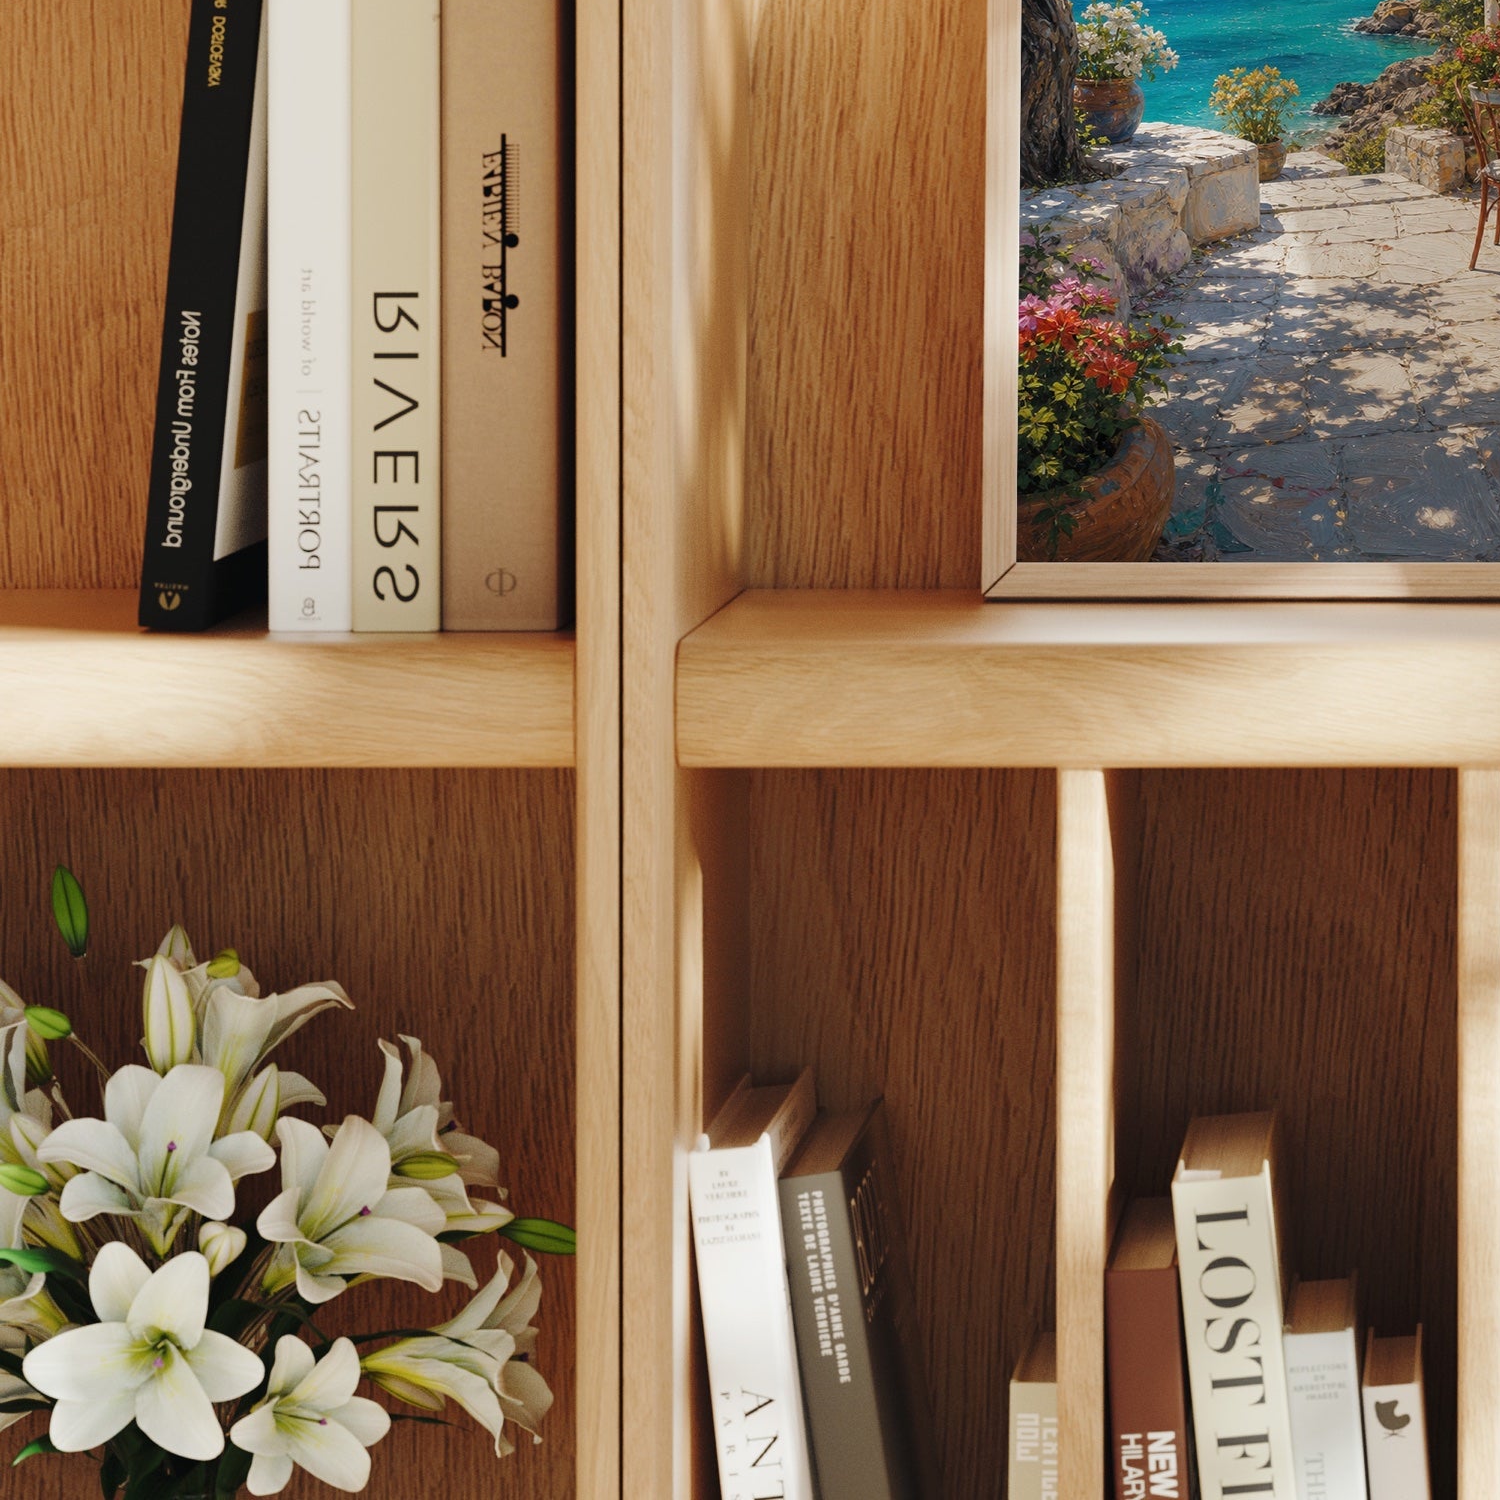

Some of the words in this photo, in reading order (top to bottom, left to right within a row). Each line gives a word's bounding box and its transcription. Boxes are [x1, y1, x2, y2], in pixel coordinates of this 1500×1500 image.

[797, 1191, 814, 1231] TEXTE
[803, 1233, 817, 1251] DE
[806, 1254, 824, 1294] LAURE
[811, 1190, 838, 1290] PHOTOGRAPHIES
[834, 1342, 852, 1384] GARDE
[1195, 1204, 1266, 1406] LOST
[1146, 1430, 1180, 1499] NEW
